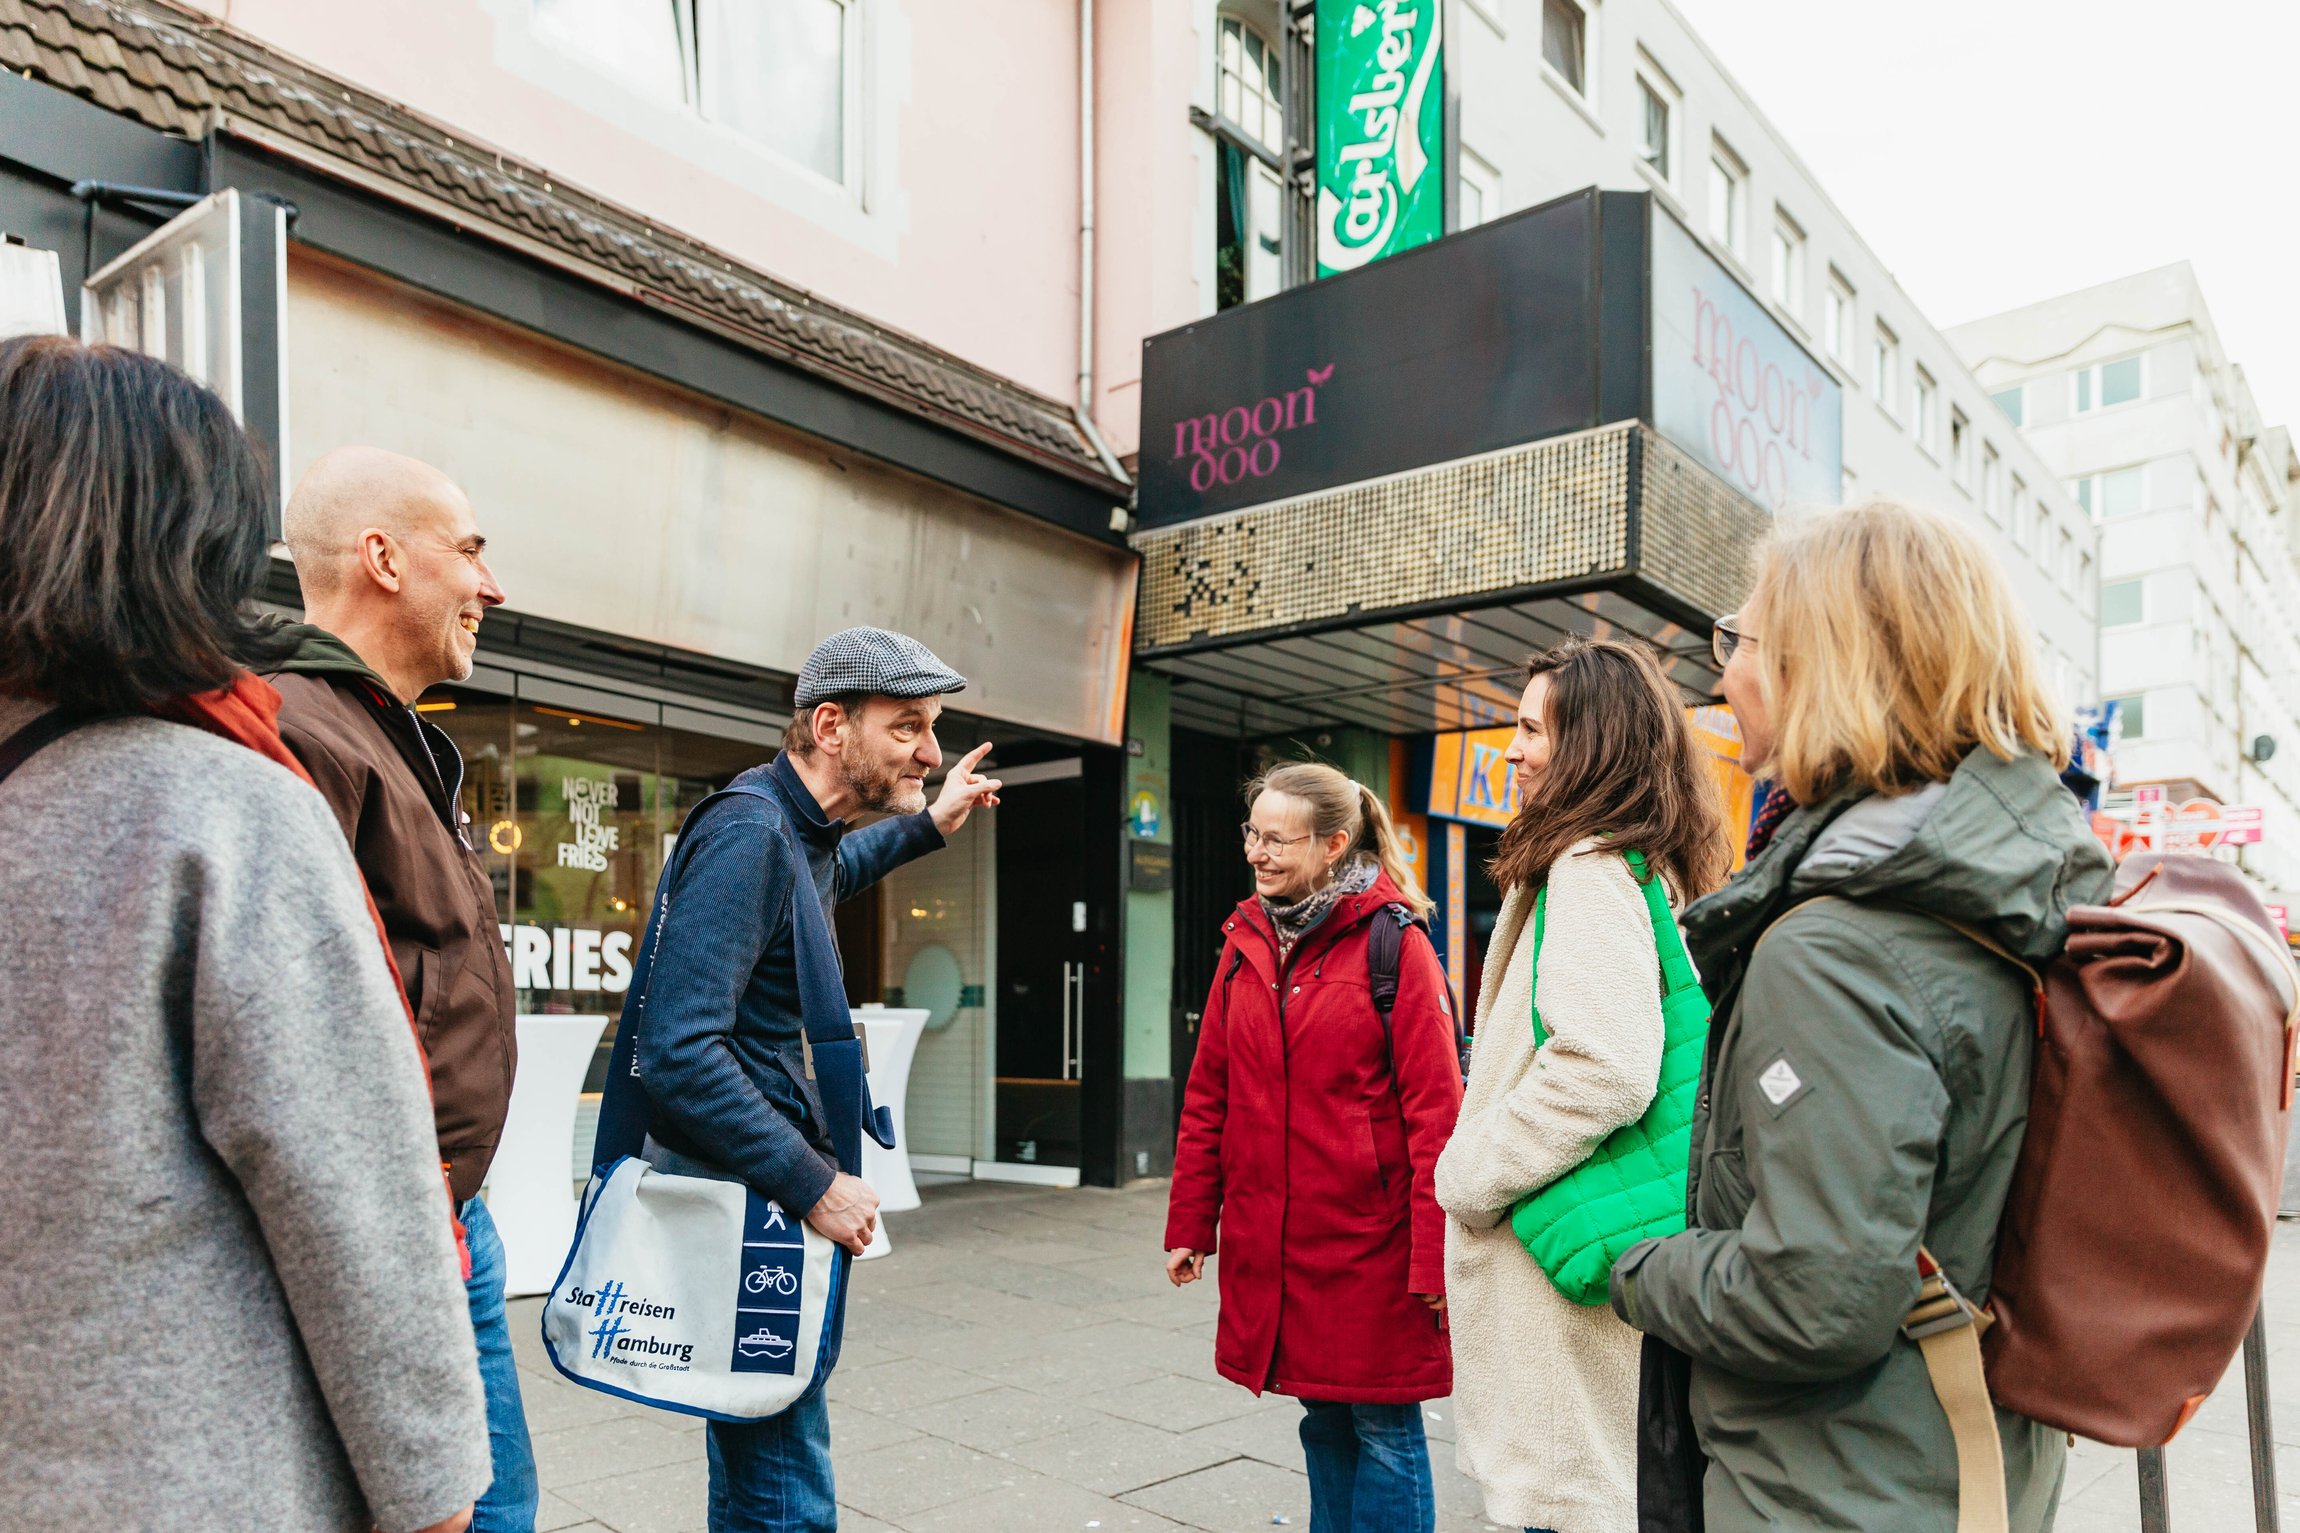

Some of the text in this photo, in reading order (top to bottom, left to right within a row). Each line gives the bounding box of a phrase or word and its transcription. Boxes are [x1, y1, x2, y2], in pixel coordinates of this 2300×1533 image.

[1317, 0, 1418, 271] Carlsber
[1693, 286, 1810, 462] moon
[1173, 386, 1318, 459] moon
[562, 776, 618, 807] NEVER
[569, 799, 600, 825] NOT
[576, 822, 619, 851] LOVE
[558, 842, 608, 872] FRIES
[588, 1316, 694, 1363] Hamburg
[610, 1356, 690, 1372] Pfade durch die Großstadt
